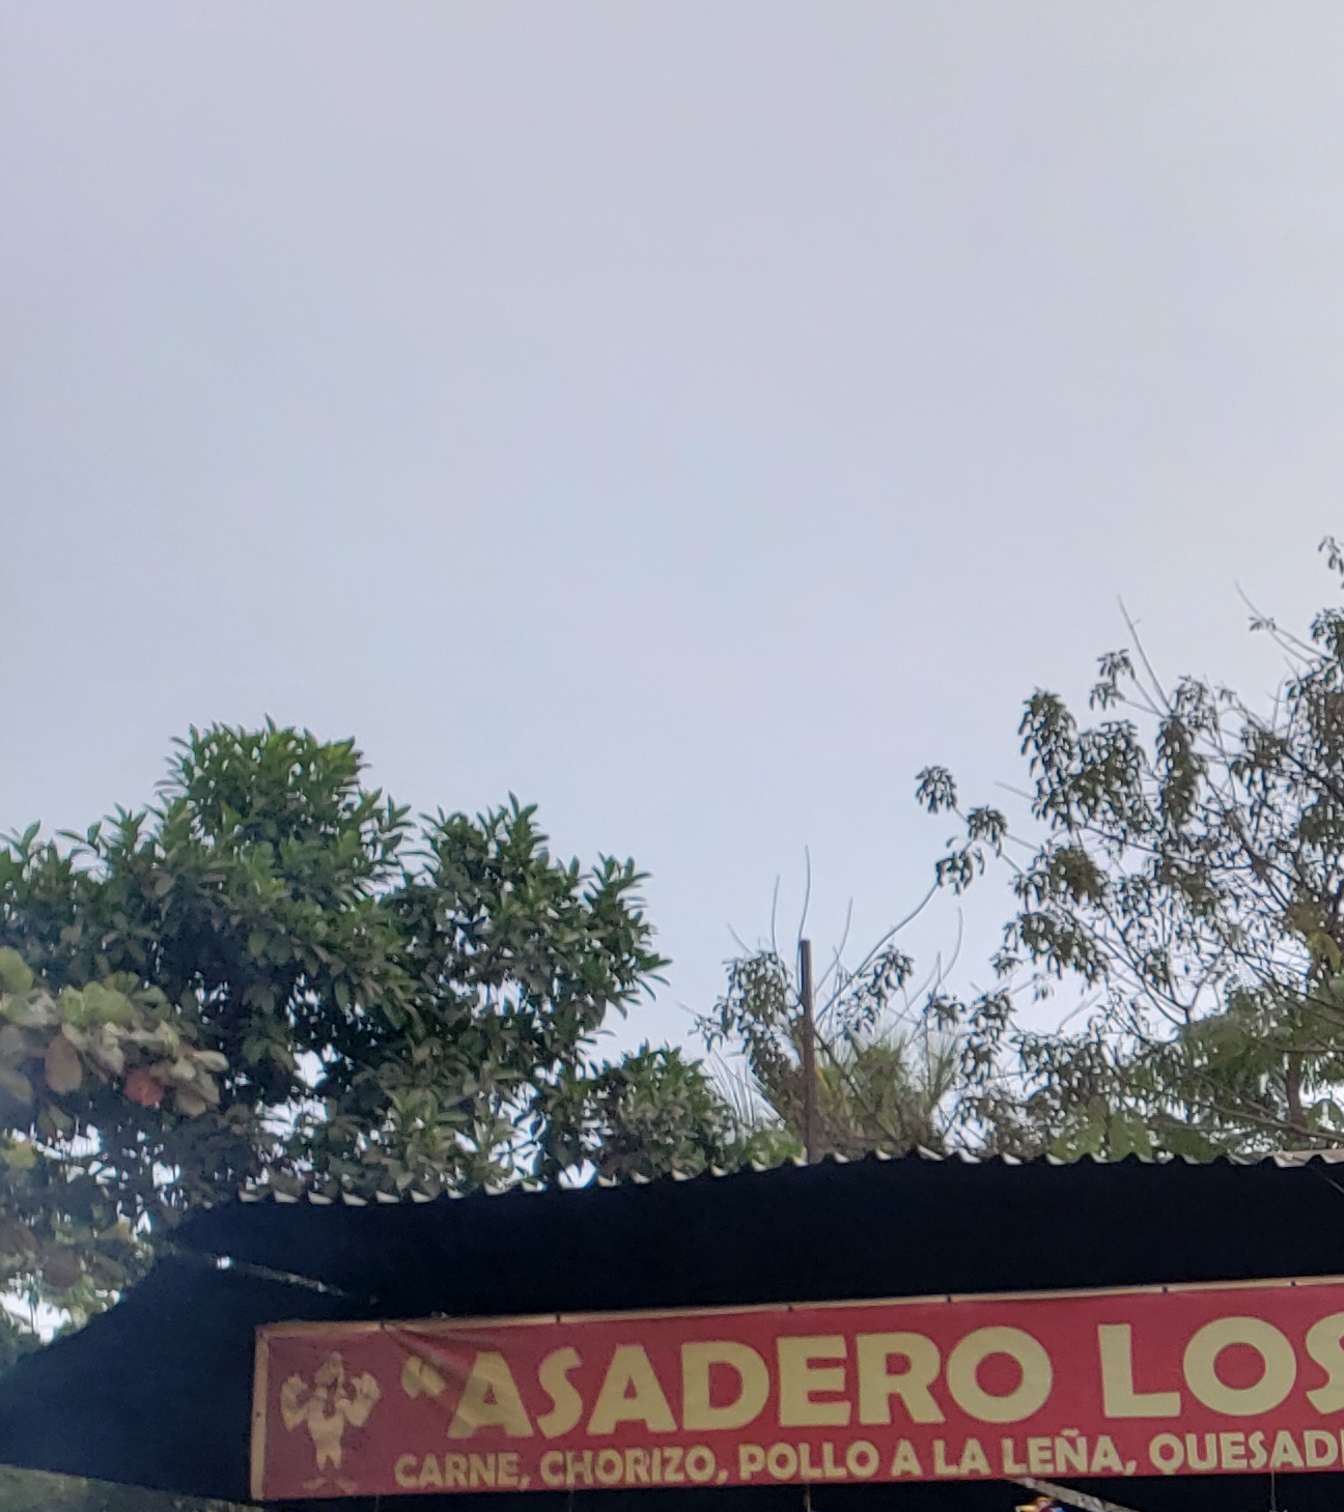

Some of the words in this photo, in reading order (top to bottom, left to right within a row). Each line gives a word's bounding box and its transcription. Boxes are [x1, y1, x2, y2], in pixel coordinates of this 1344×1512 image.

[394, 1451, 530, 1491] CARNE,
[540, 1444, 728, 1486] CHORIZO,
[739, 1440, 876, 1480] POLLO
[891, 1438, 922, 1476] A
[934, 1438, 991, 1476] LA
[1003, 1429, 1137, 1477] LEÑA,
